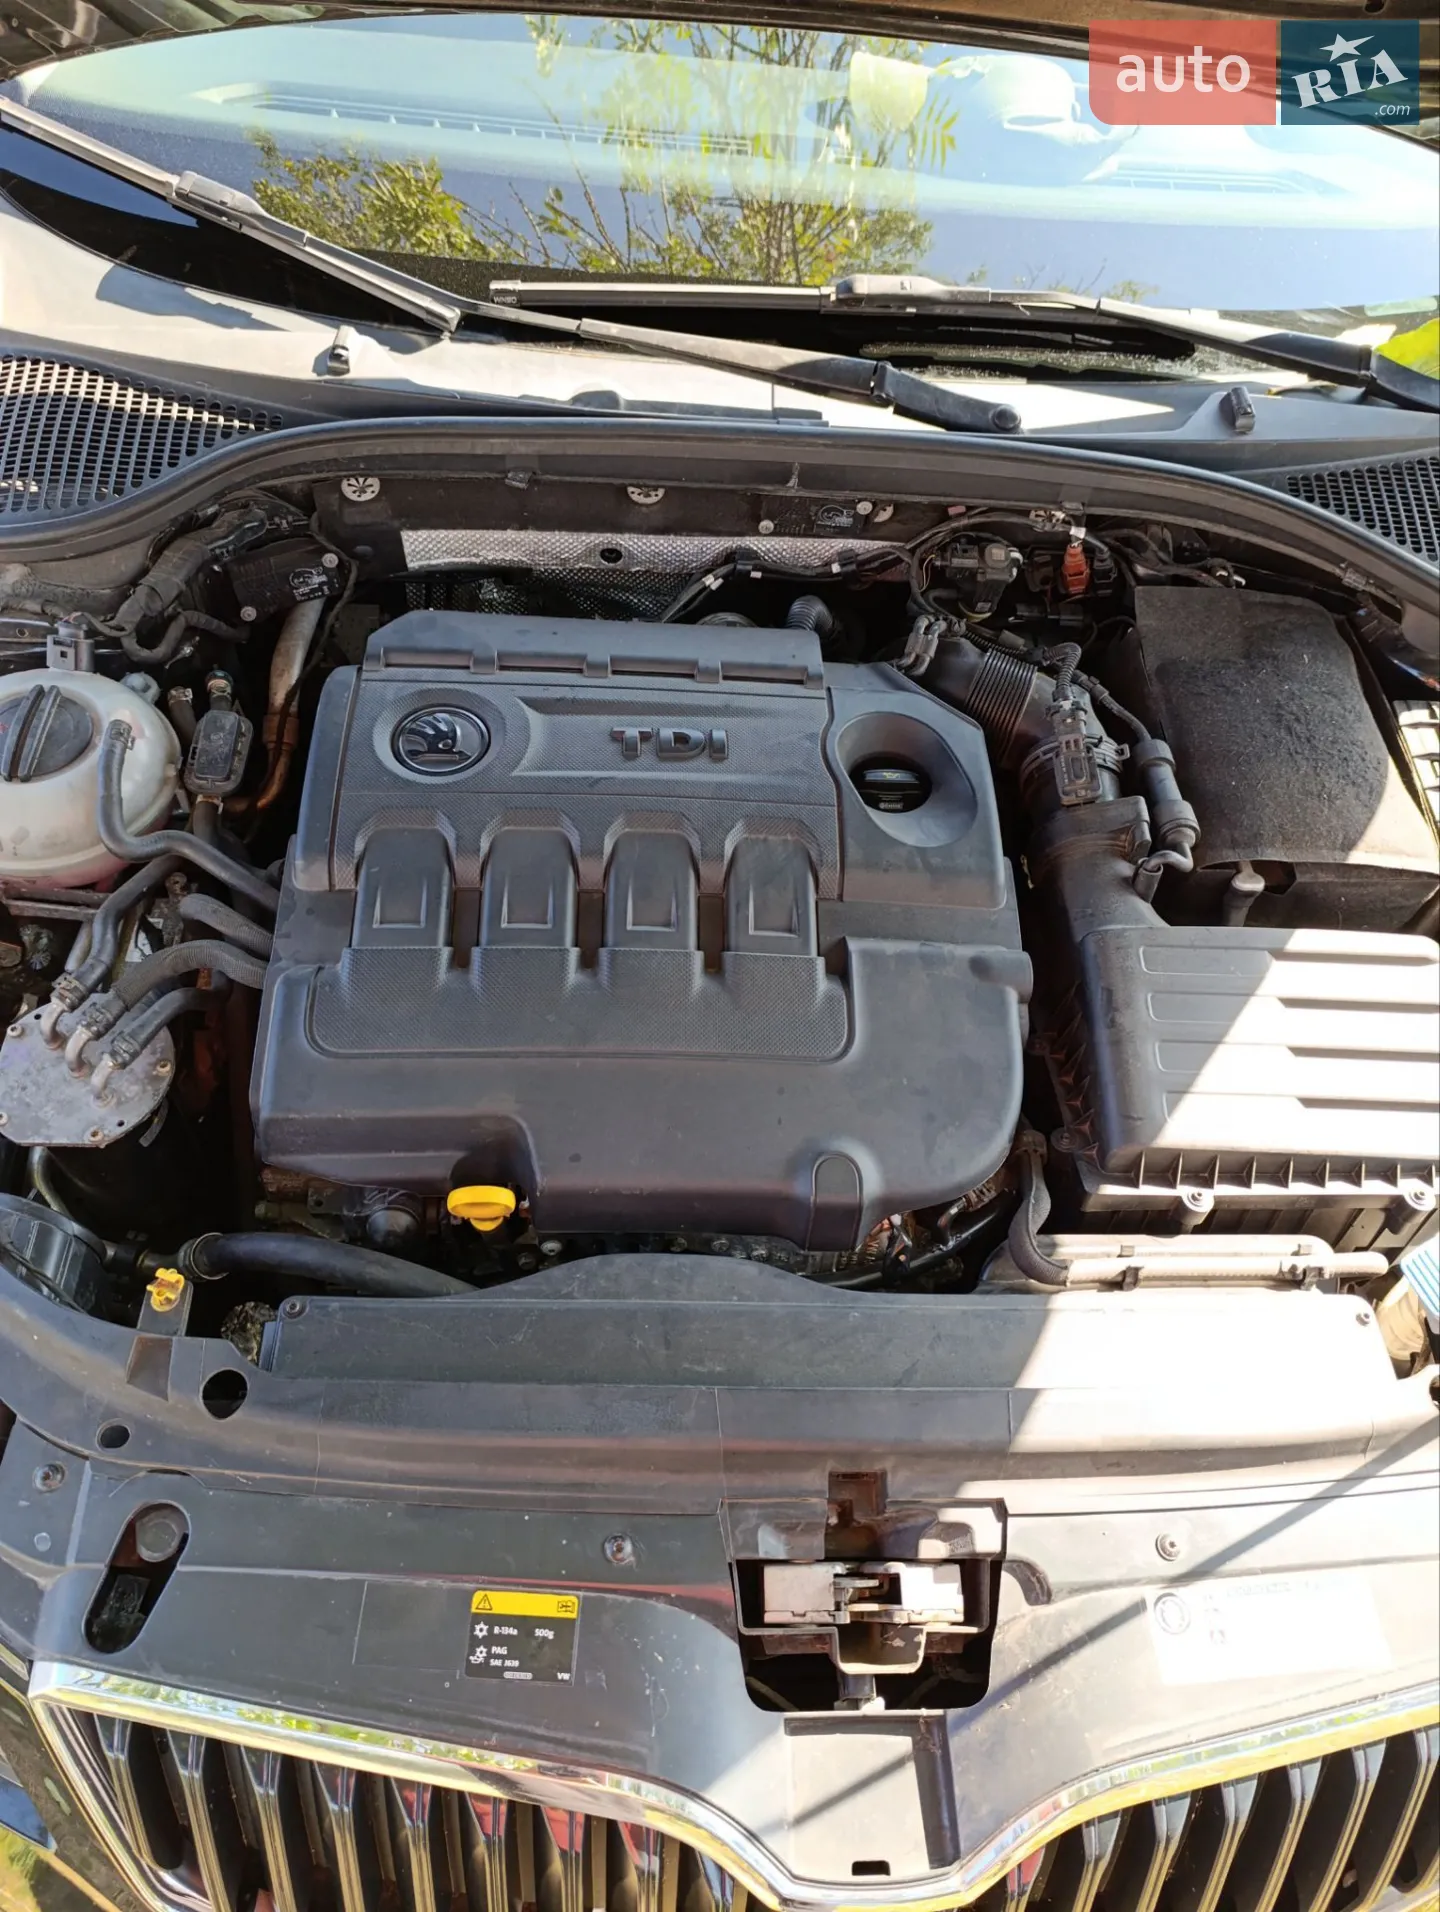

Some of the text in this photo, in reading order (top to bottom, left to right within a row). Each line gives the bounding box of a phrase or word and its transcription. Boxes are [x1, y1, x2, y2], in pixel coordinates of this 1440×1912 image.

[609, 726, 729, 761] TDI
[493, 1625, 555, 1640] R-134a 500g
[491, 1645, 508, 1655] PAG
[489, 1658, 503, 1667] SAE
[556, 1672, 571, 1681] VW
